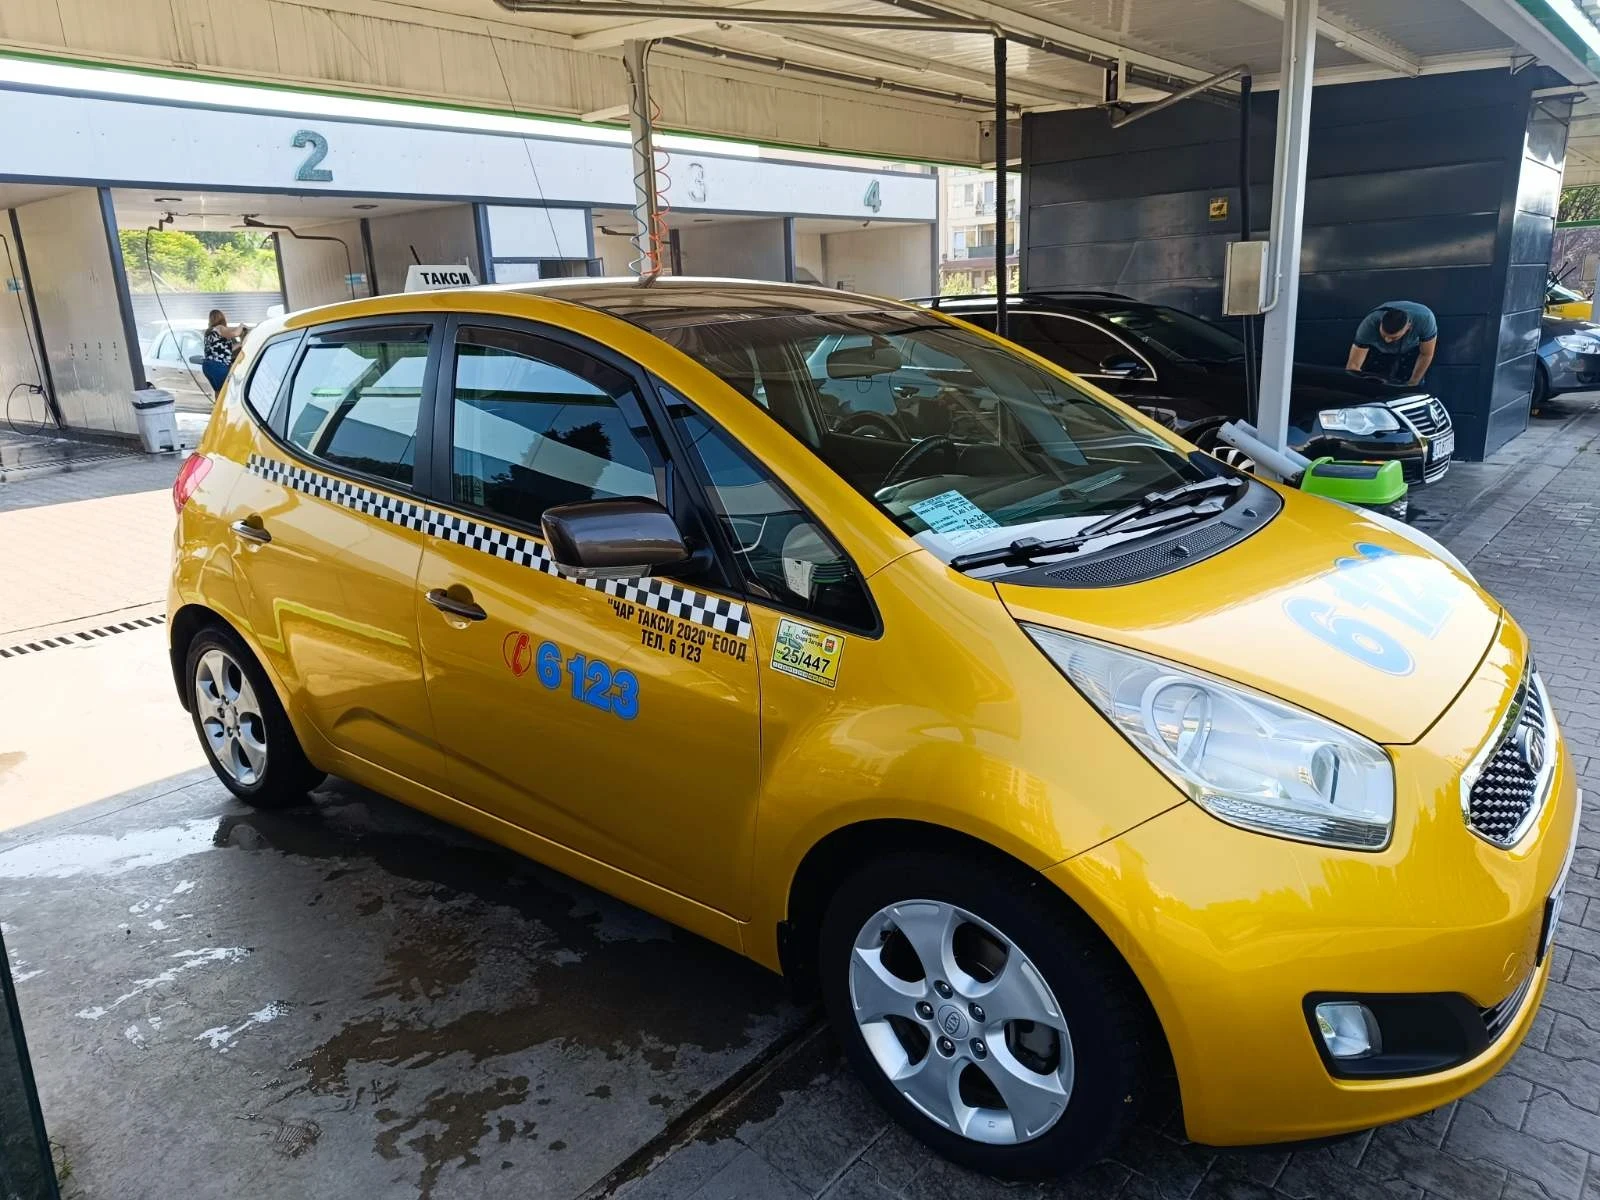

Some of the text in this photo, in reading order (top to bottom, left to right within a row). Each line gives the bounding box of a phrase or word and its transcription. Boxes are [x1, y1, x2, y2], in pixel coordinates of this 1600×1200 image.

[291, 129, 334, 183] 2
[687, 162, 707, 203] 3
[863, 178, 882, 215] 4
[420, 272, 471, 285] ТАКСИ
[637, 608, 675, 636] ТАКСИ
[641, 628, 666, 652] ТЕЛ.
[680, 642, 702, 663] 123
[781, 646, 831, 673] 25/447
